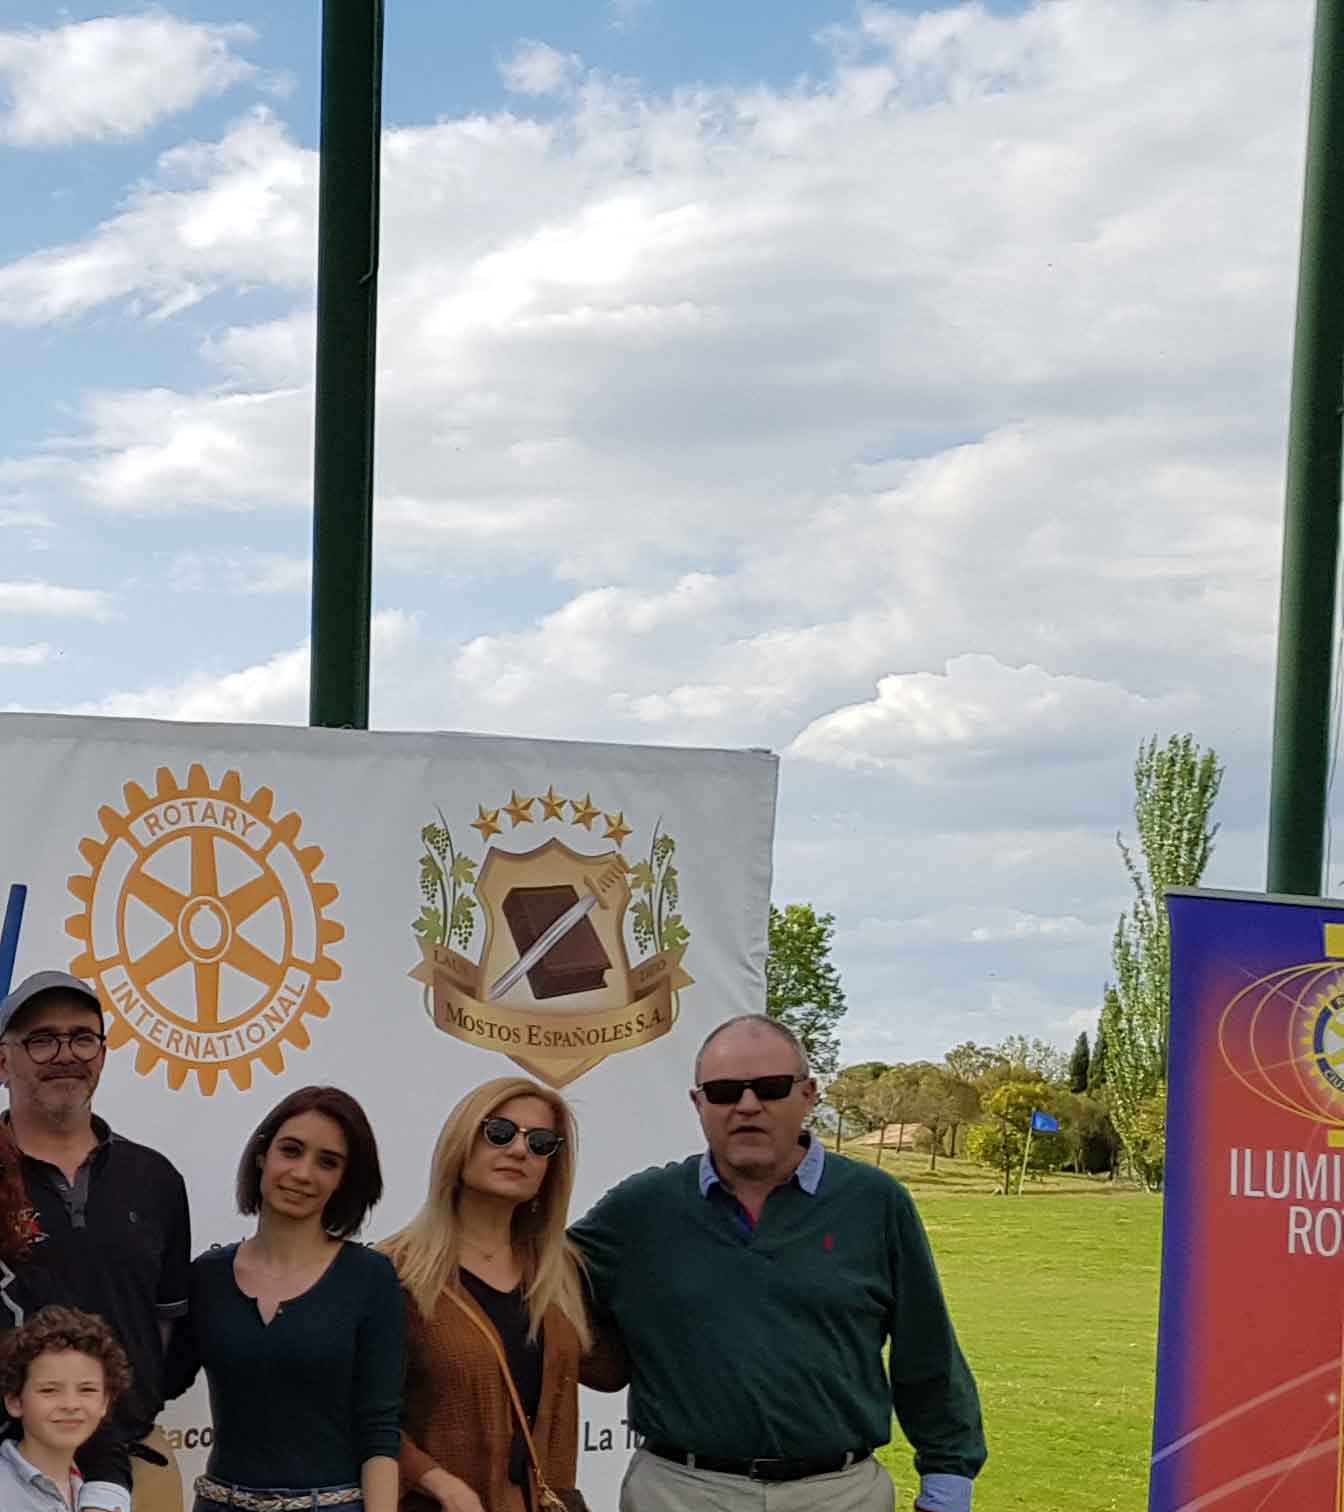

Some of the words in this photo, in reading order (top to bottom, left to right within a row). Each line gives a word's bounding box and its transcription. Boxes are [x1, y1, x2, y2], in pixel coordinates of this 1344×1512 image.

[143, 800, 257, 838] ROTARY
[111, 980, 306, 1059] INTERNATIONAL
[446, 1002, 521, 1044] MOSTOS
[527, 1020, 633, 1048] ESPAÑOLES
[635, 1007, 665, 1033] S.A.
[1229, 1147, 1344, 1200] ILUMI
[1287, 1206, 1344, 1258] RO
[584, 1420, 613, 1451] La
